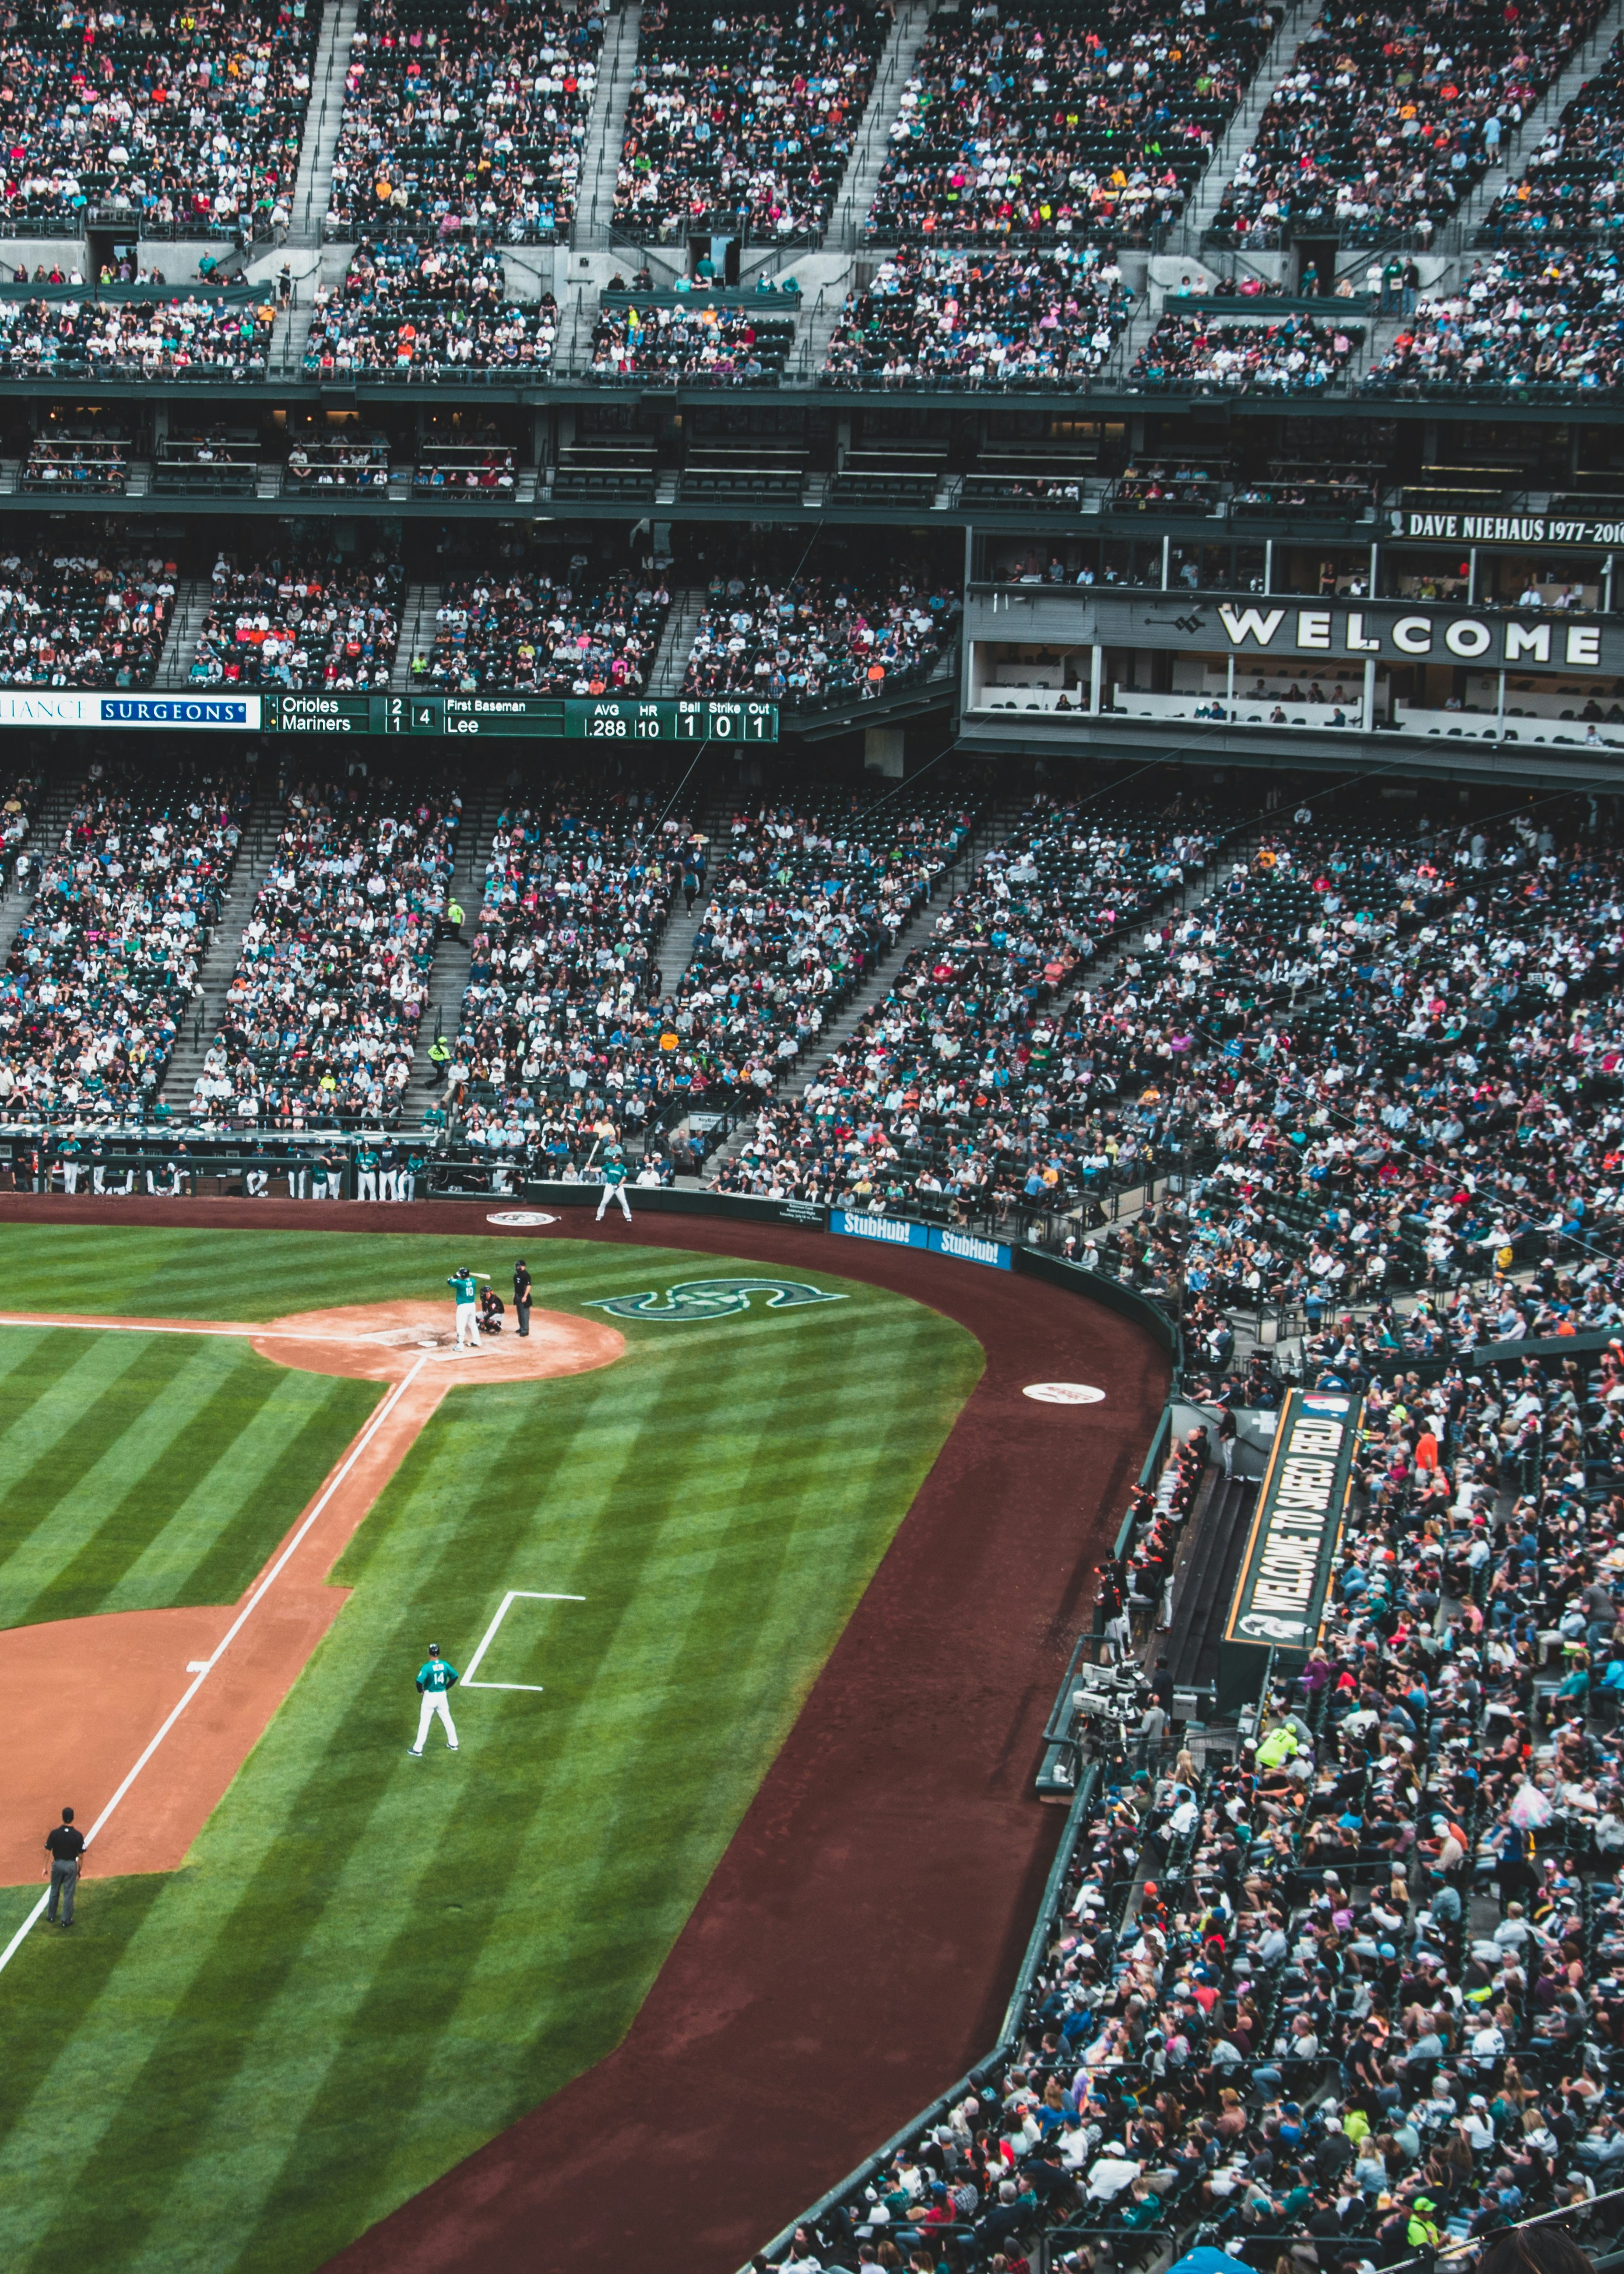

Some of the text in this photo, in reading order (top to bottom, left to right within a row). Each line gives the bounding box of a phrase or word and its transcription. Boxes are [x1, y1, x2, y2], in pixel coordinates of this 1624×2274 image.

[1410, 514, 1457, 537] DAVE
[1463, 516, 1544, 541] NIEHAUS
[1217, 607, 1602, 665] WELCOME
[283, 696, 402, 714] Orioles 2
[420, 699, 526, 724] 4 First Baseman
[594, 701, 769, 717] AVG HR Ball Strike Out
[283, 715, 400, 732] Mariners 1
[448, 717, 479, 733] Lee
[589, 715, 763, 738] .288 10 1 0 1
[843, 1208, 883, 1217] mariners.com
[844, 1212, 910, 1243] StubHub!
[941, 1230, 999, 1264] StubHub!
[466, 1286, 473, 1297] 10
[1250, 1419, 1343, 1612] WELCOME TO SAFECO FIELD
[434, 1672, 444, 1685] 14
